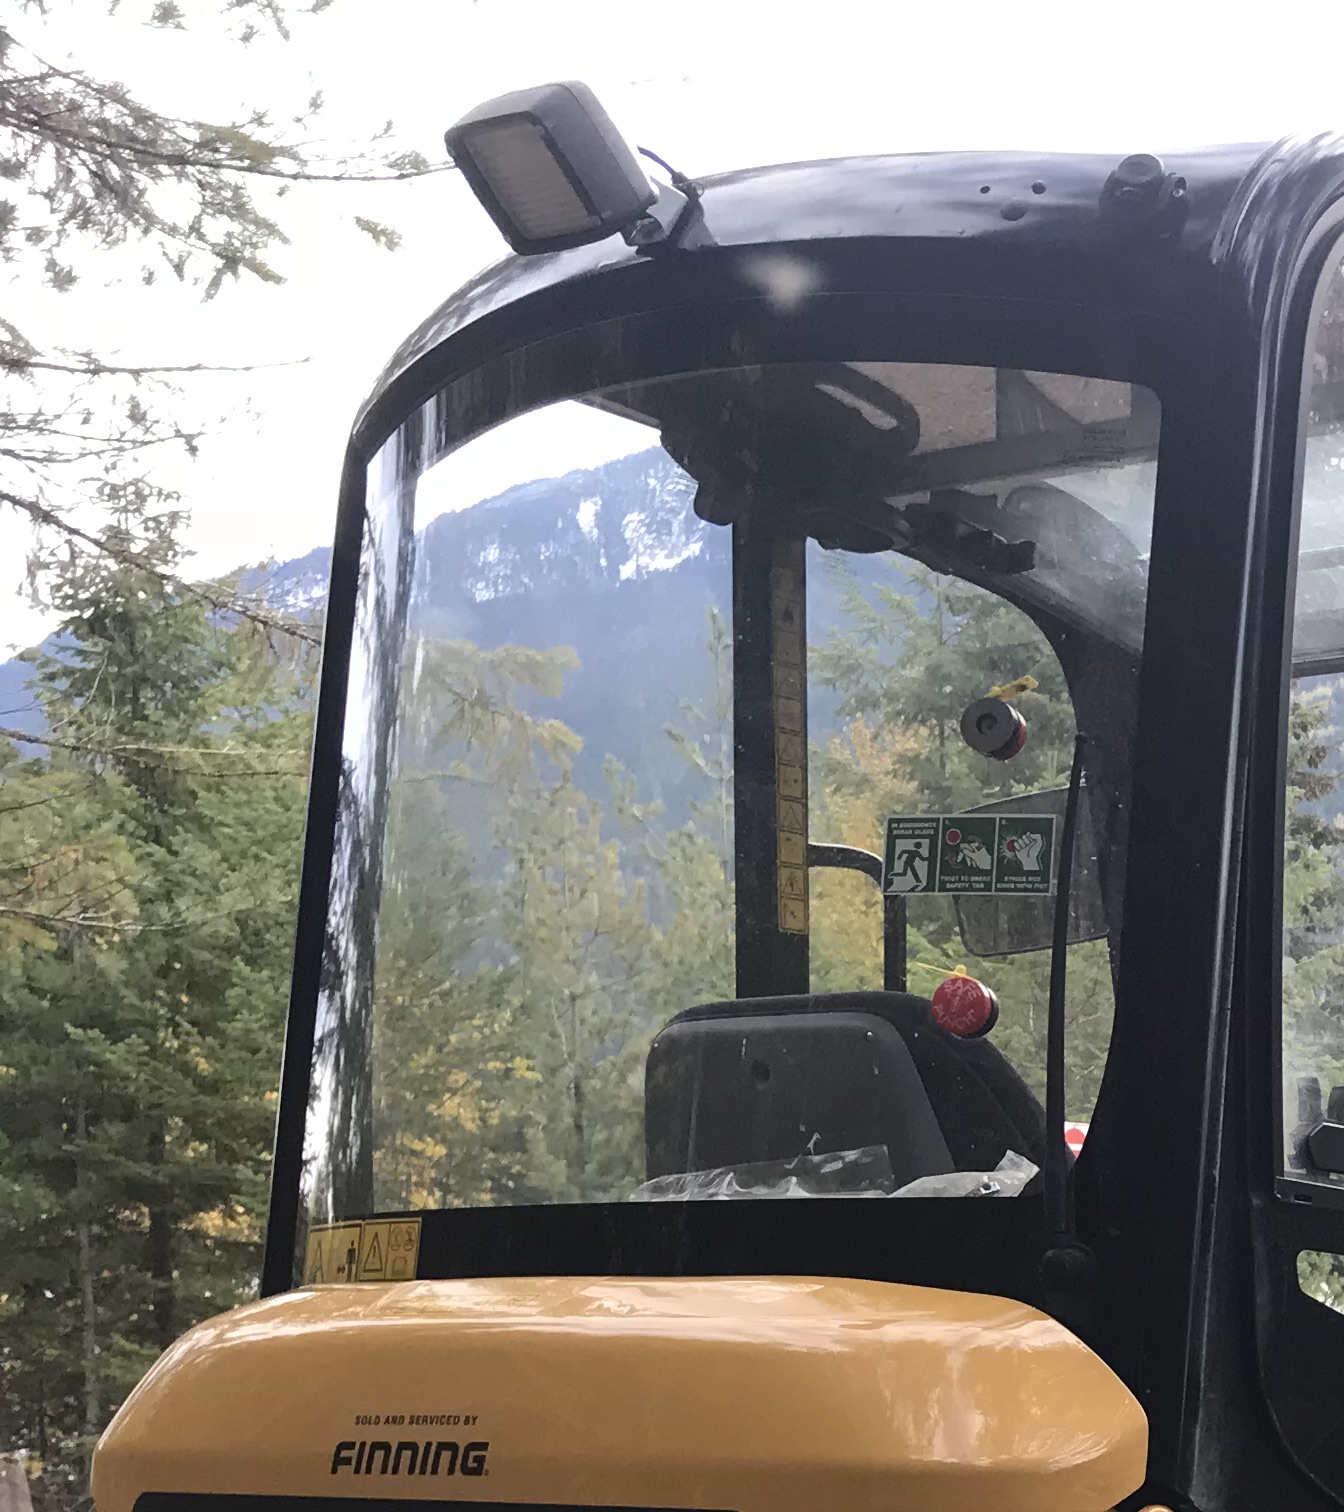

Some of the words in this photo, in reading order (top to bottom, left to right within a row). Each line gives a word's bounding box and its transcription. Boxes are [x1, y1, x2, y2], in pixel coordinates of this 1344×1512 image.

[354, 1414, 380, 1426] SOLD
[383, 1414, 405, 1426] AND
[408, 1414, 460, 1426] SERVICED
[463, 1414, 479, 1426] BY
[330, 1441, 490, 1477] FINNING
